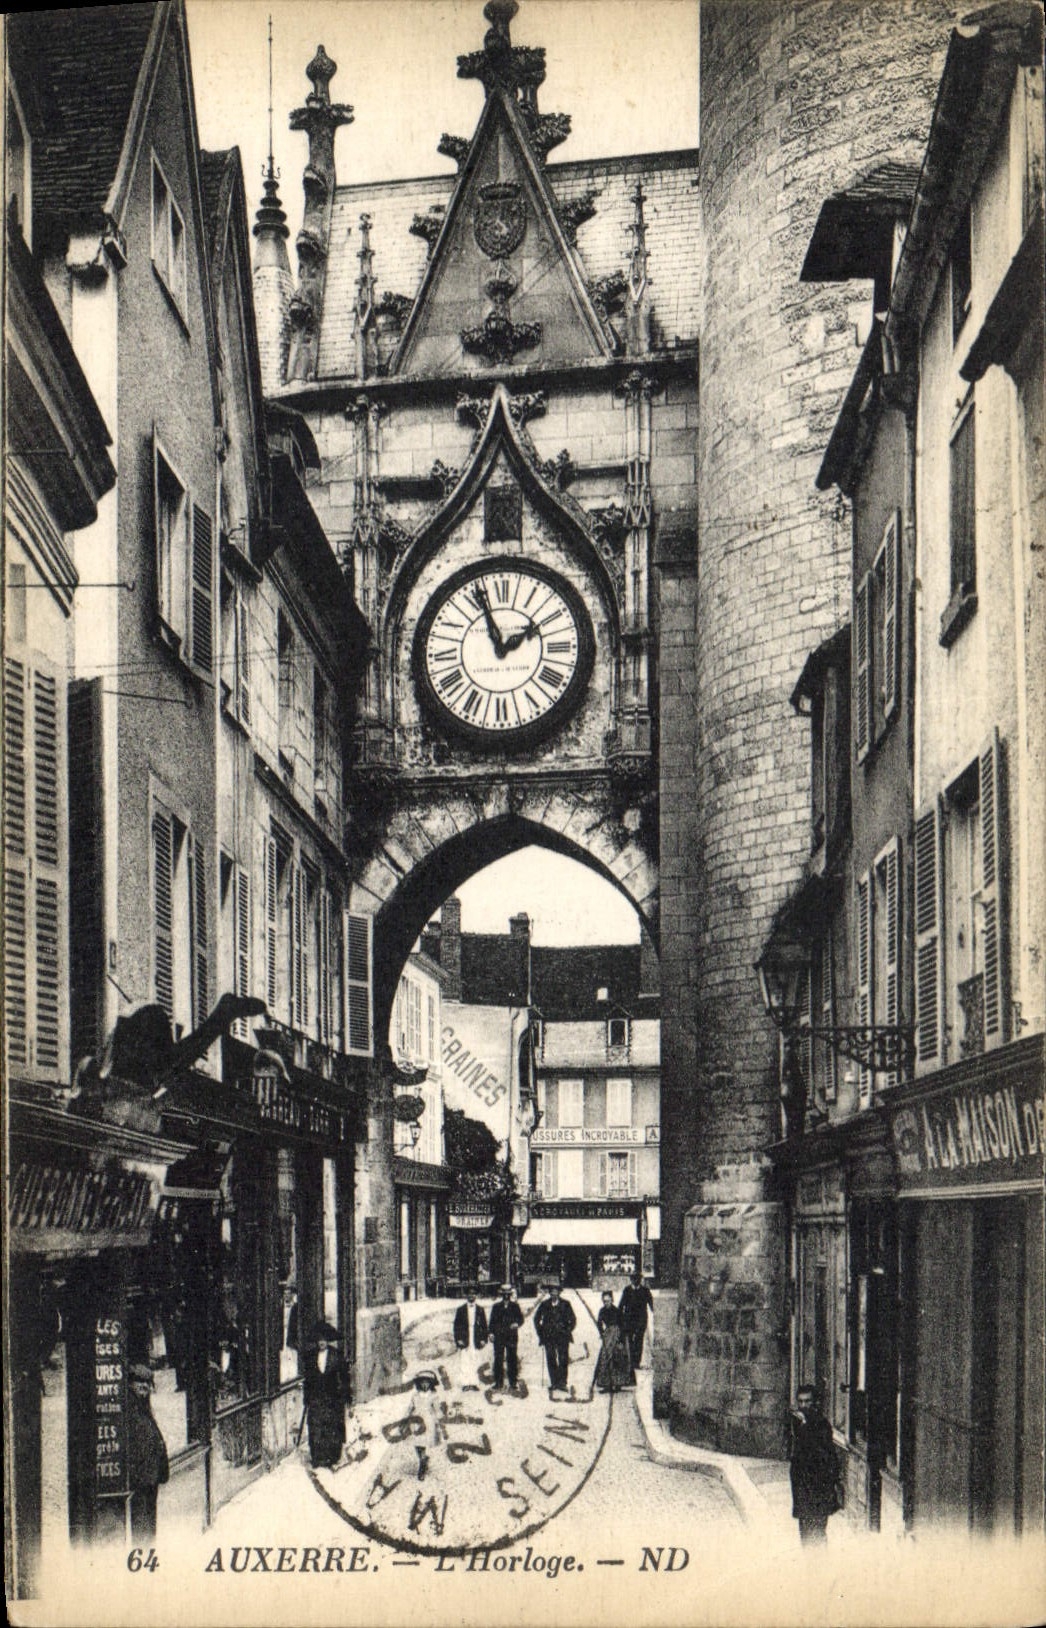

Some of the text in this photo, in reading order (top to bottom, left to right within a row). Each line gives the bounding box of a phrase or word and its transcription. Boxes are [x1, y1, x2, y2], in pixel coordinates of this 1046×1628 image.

[547, 641, 571, 653] III
[441, 1026, 507, 1107] GRAINES
[581, 1128, 639, 1141] INCROYABLE
[921, 1102, 938, 1169] A
[955, 1086, 1025, 1168] MAISON
